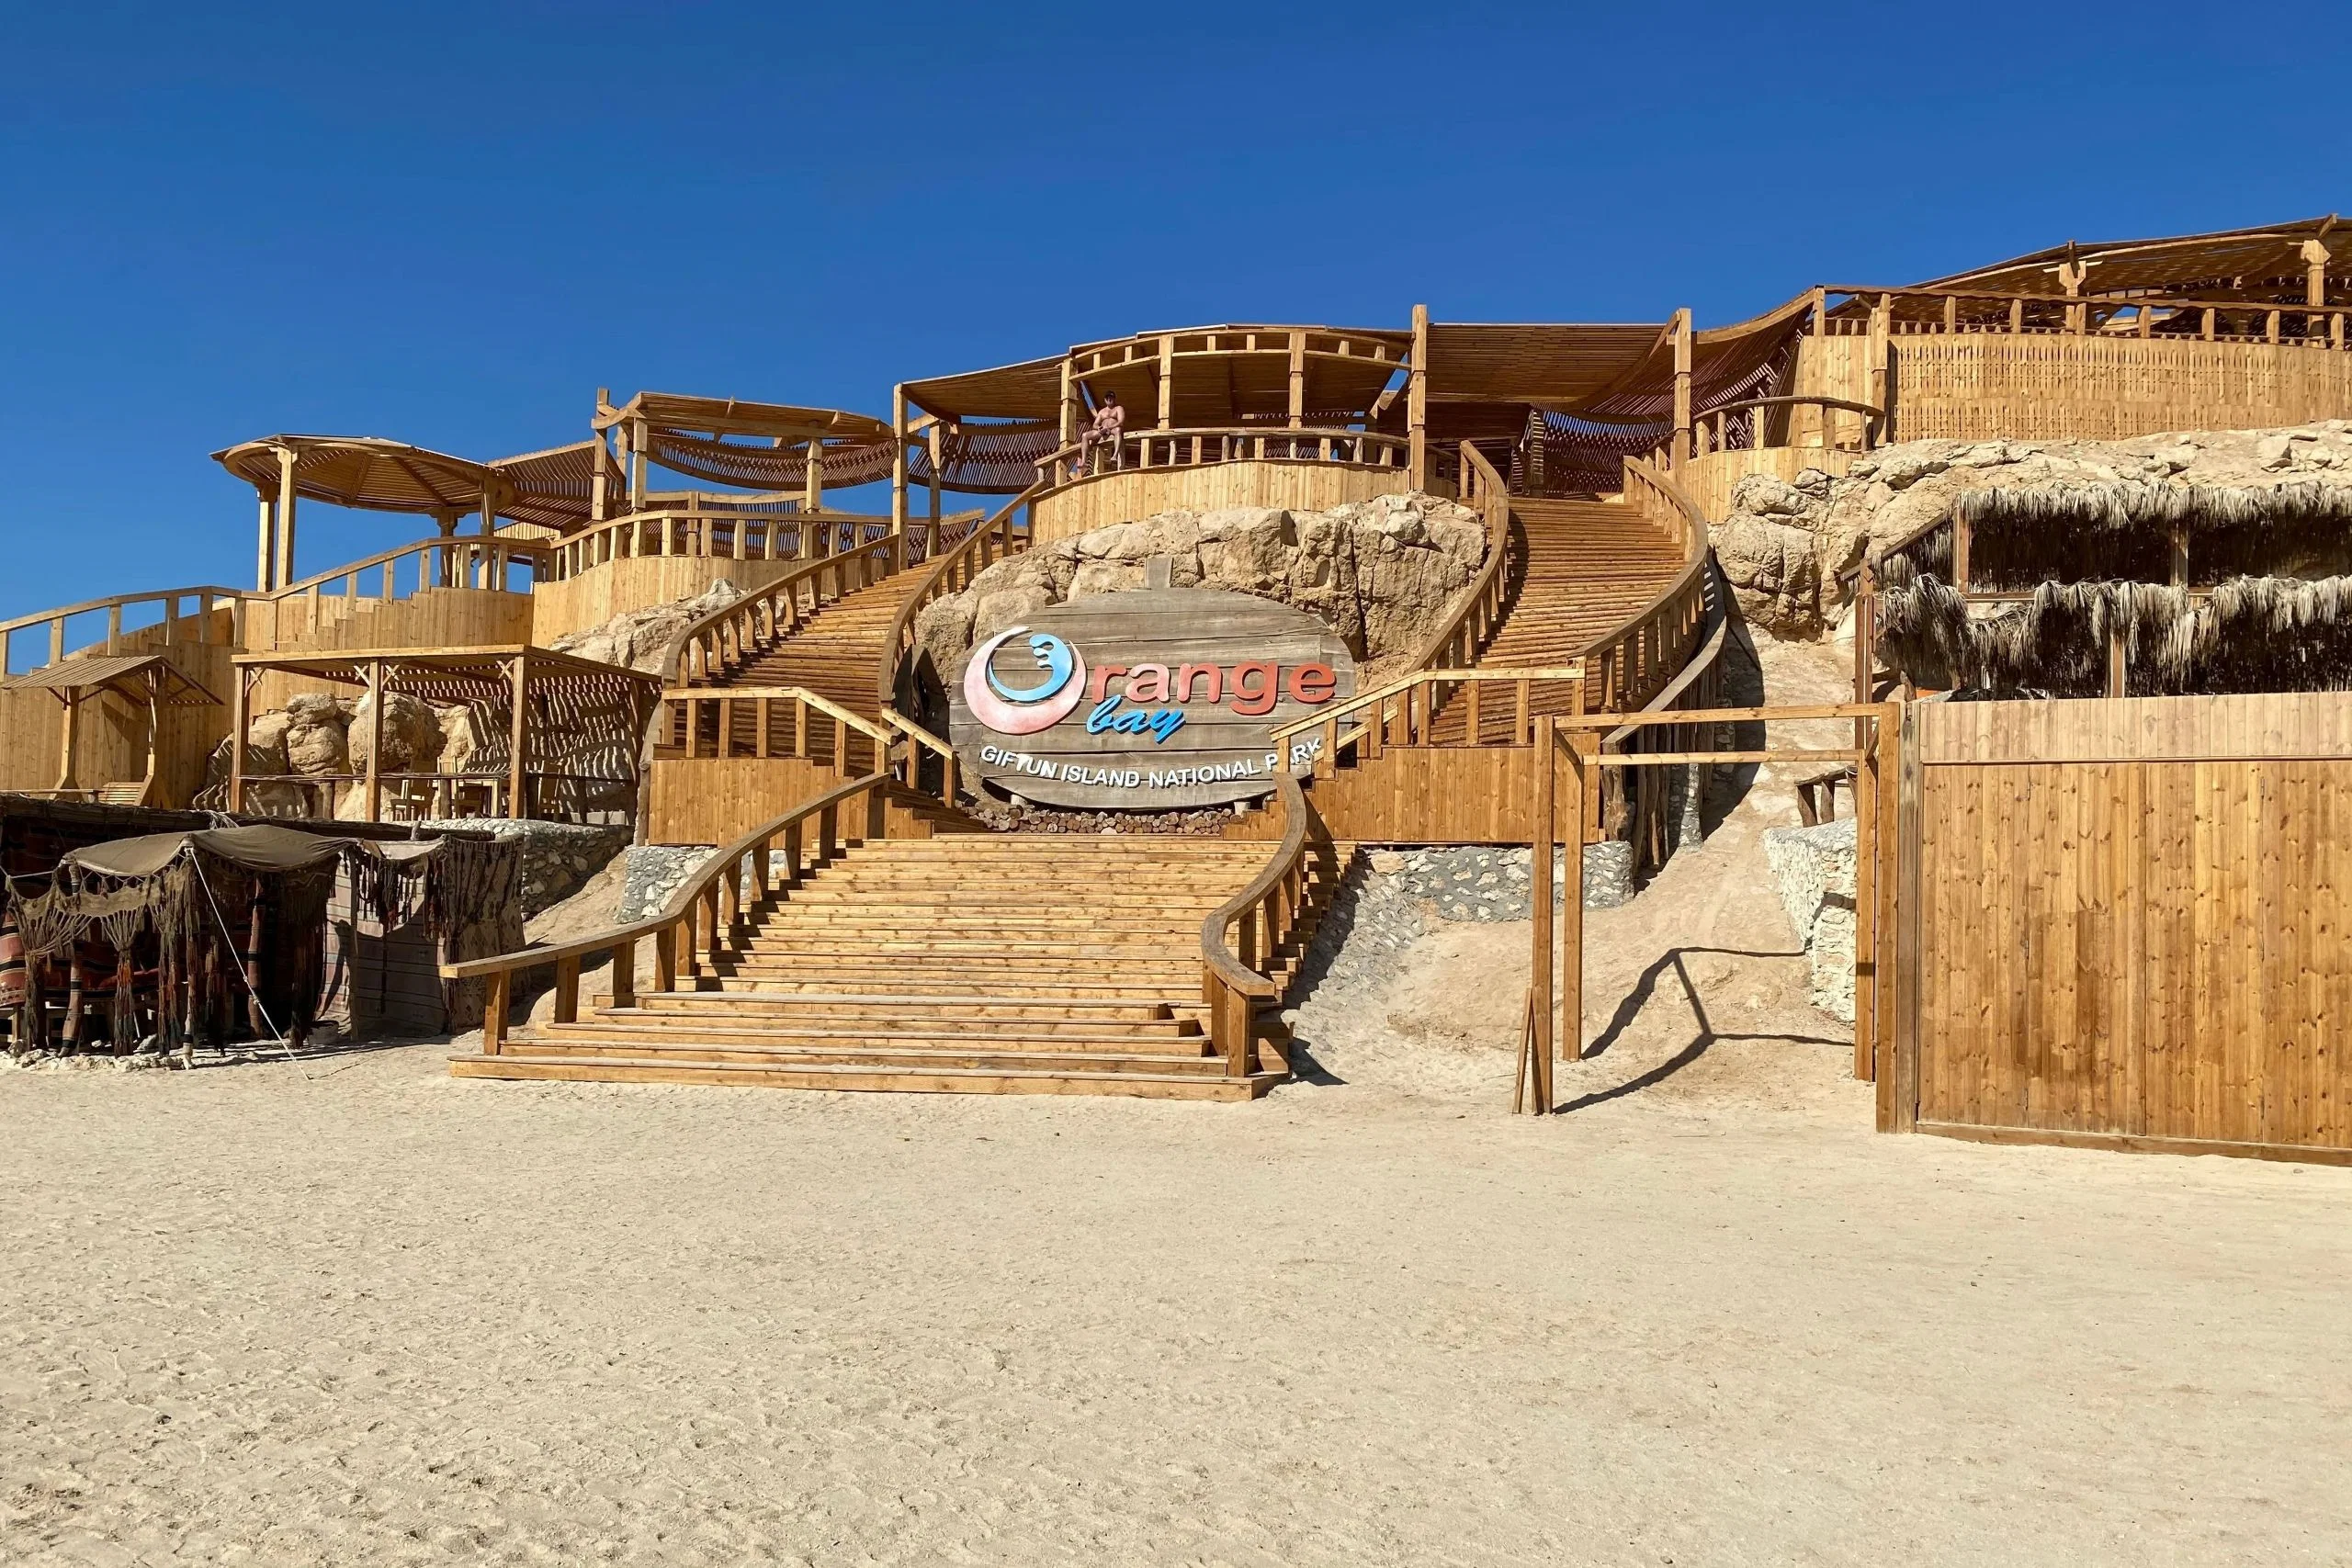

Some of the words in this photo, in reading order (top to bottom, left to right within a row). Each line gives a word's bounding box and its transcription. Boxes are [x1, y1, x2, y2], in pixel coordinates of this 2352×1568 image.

[1086, 694, 1186, 743] bay
[980, 745, 1057, 779] GIFTUN
[1060, 763, 1140, 788] ISLAND
[1148, 759, 1261, 788] NATIONAL
[1265, 737, 1322, 772] PRK
